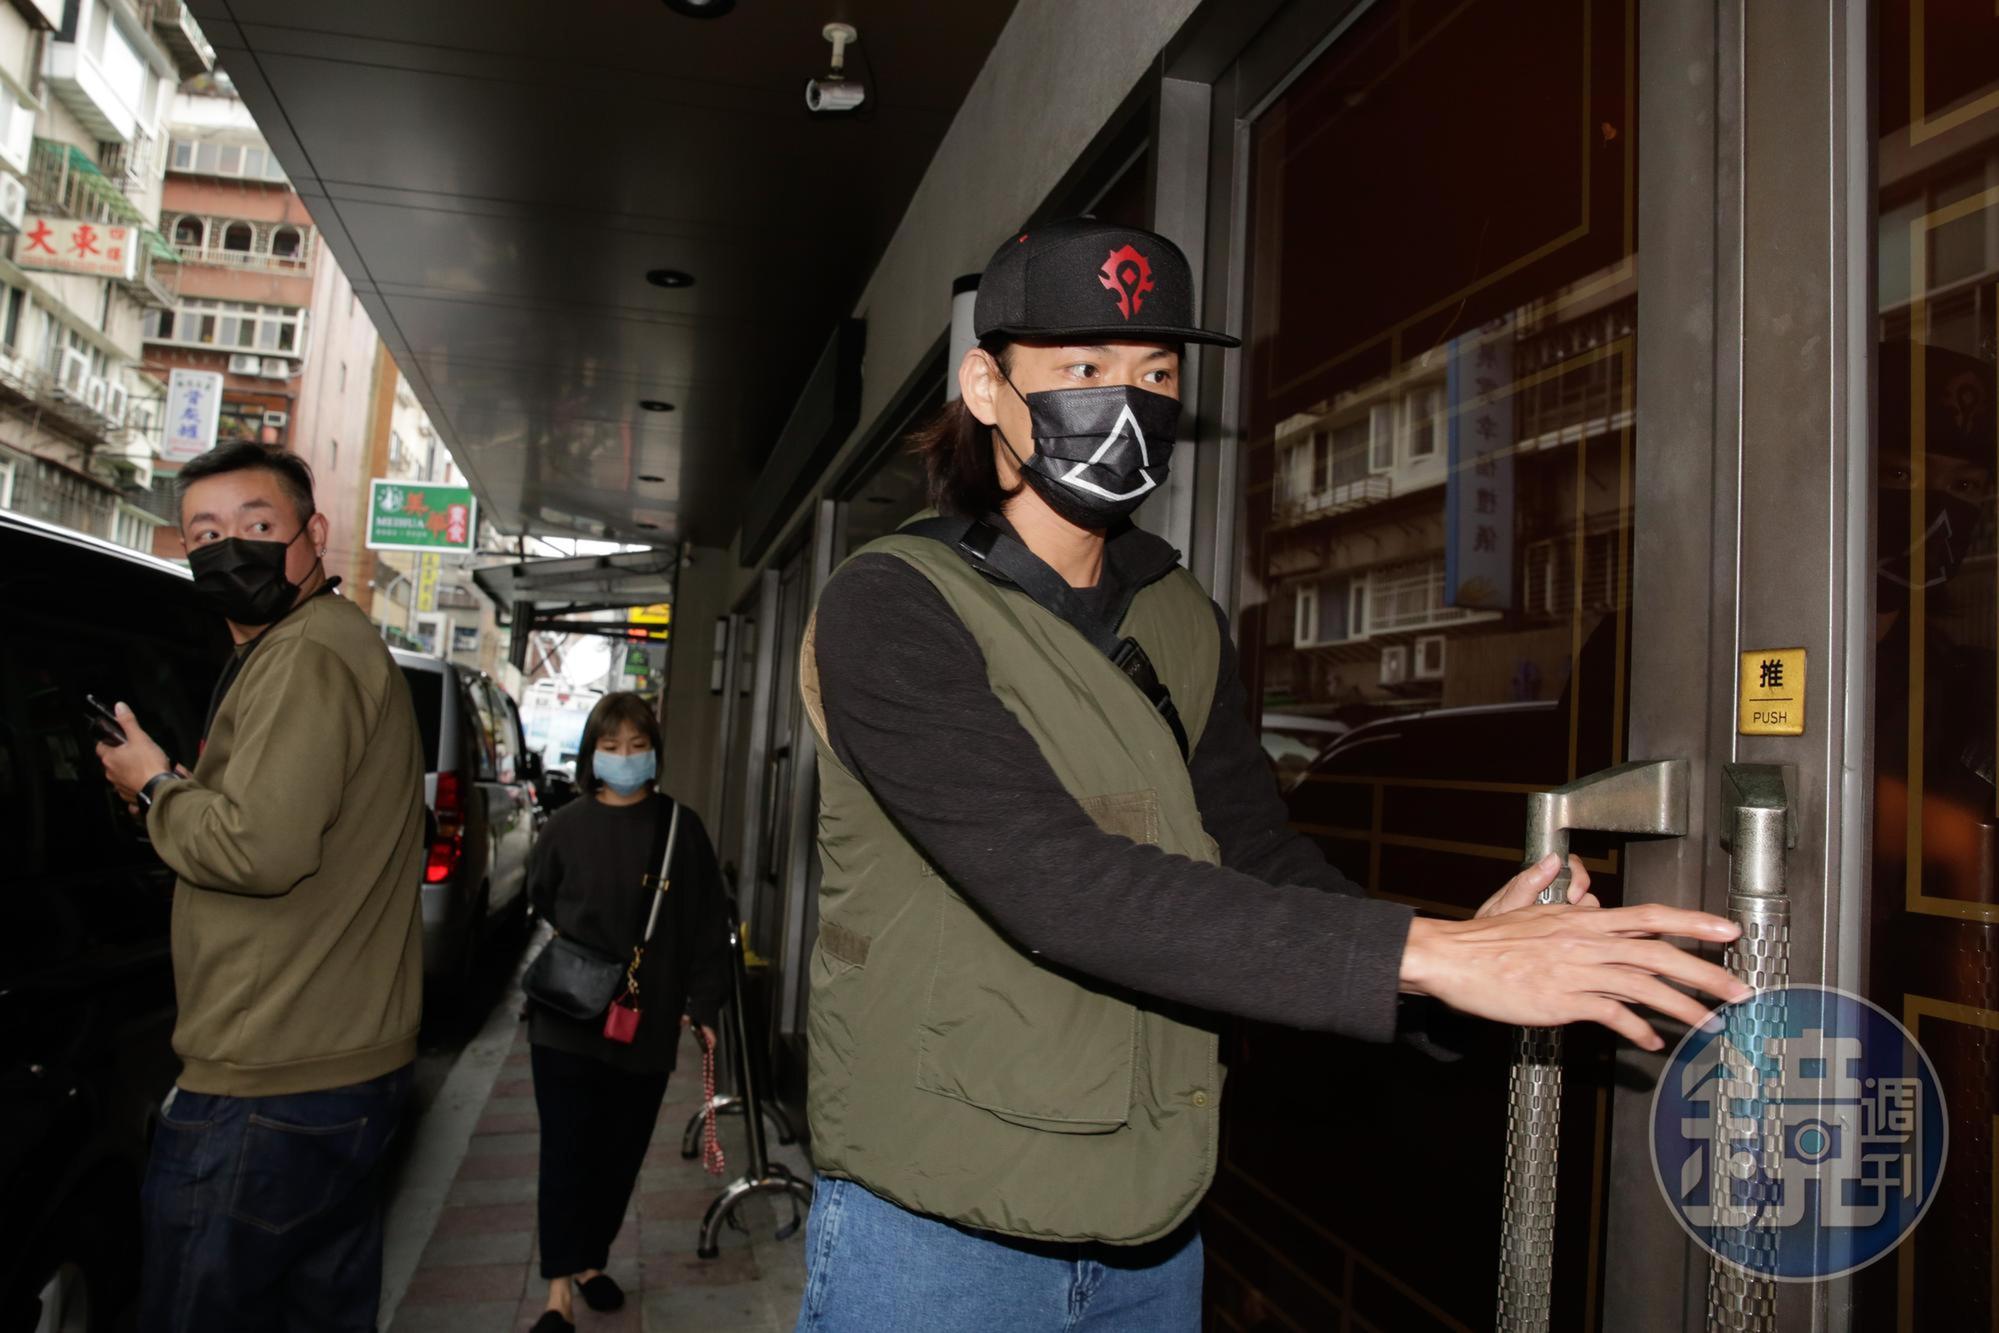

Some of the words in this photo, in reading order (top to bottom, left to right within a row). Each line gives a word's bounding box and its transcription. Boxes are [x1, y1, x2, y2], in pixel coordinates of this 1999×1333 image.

[24, 219, 102, 258] 大東
[376, 516, 425, 528] MEIHUA
[1759, 659, 1784, 688] 推
[1753, 711, 1787, 725] PUSH
